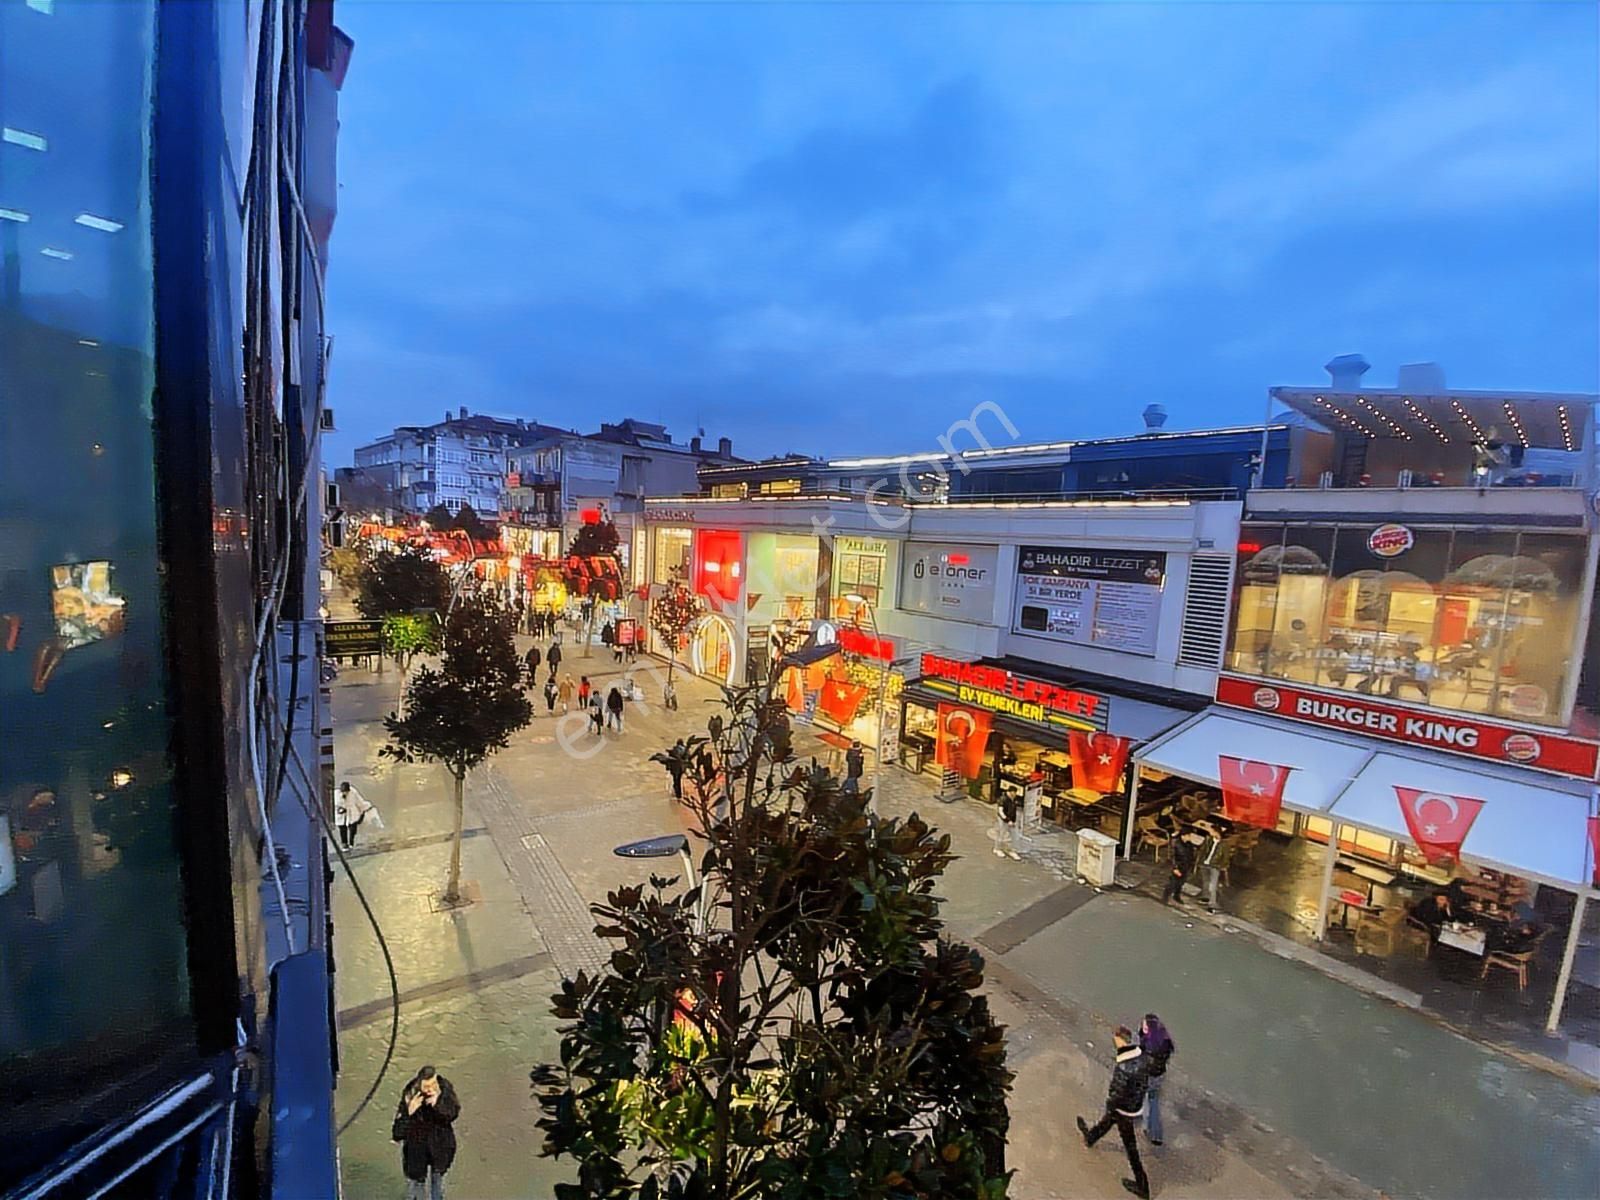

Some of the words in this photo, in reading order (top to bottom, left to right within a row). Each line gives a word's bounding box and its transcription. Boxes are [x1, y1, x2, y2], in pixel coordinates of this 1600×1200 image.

[1371, 536, 1409, 550] KING
[1036, 553, 1091, 567] BAHADIR
[1095, 557, 1144, 570] LEZZET
[1011, 677, 1098, 716] LEZZET
[1296, 697, 1397, 733] BURGER
[1405, 718, 1478, 748] KING
